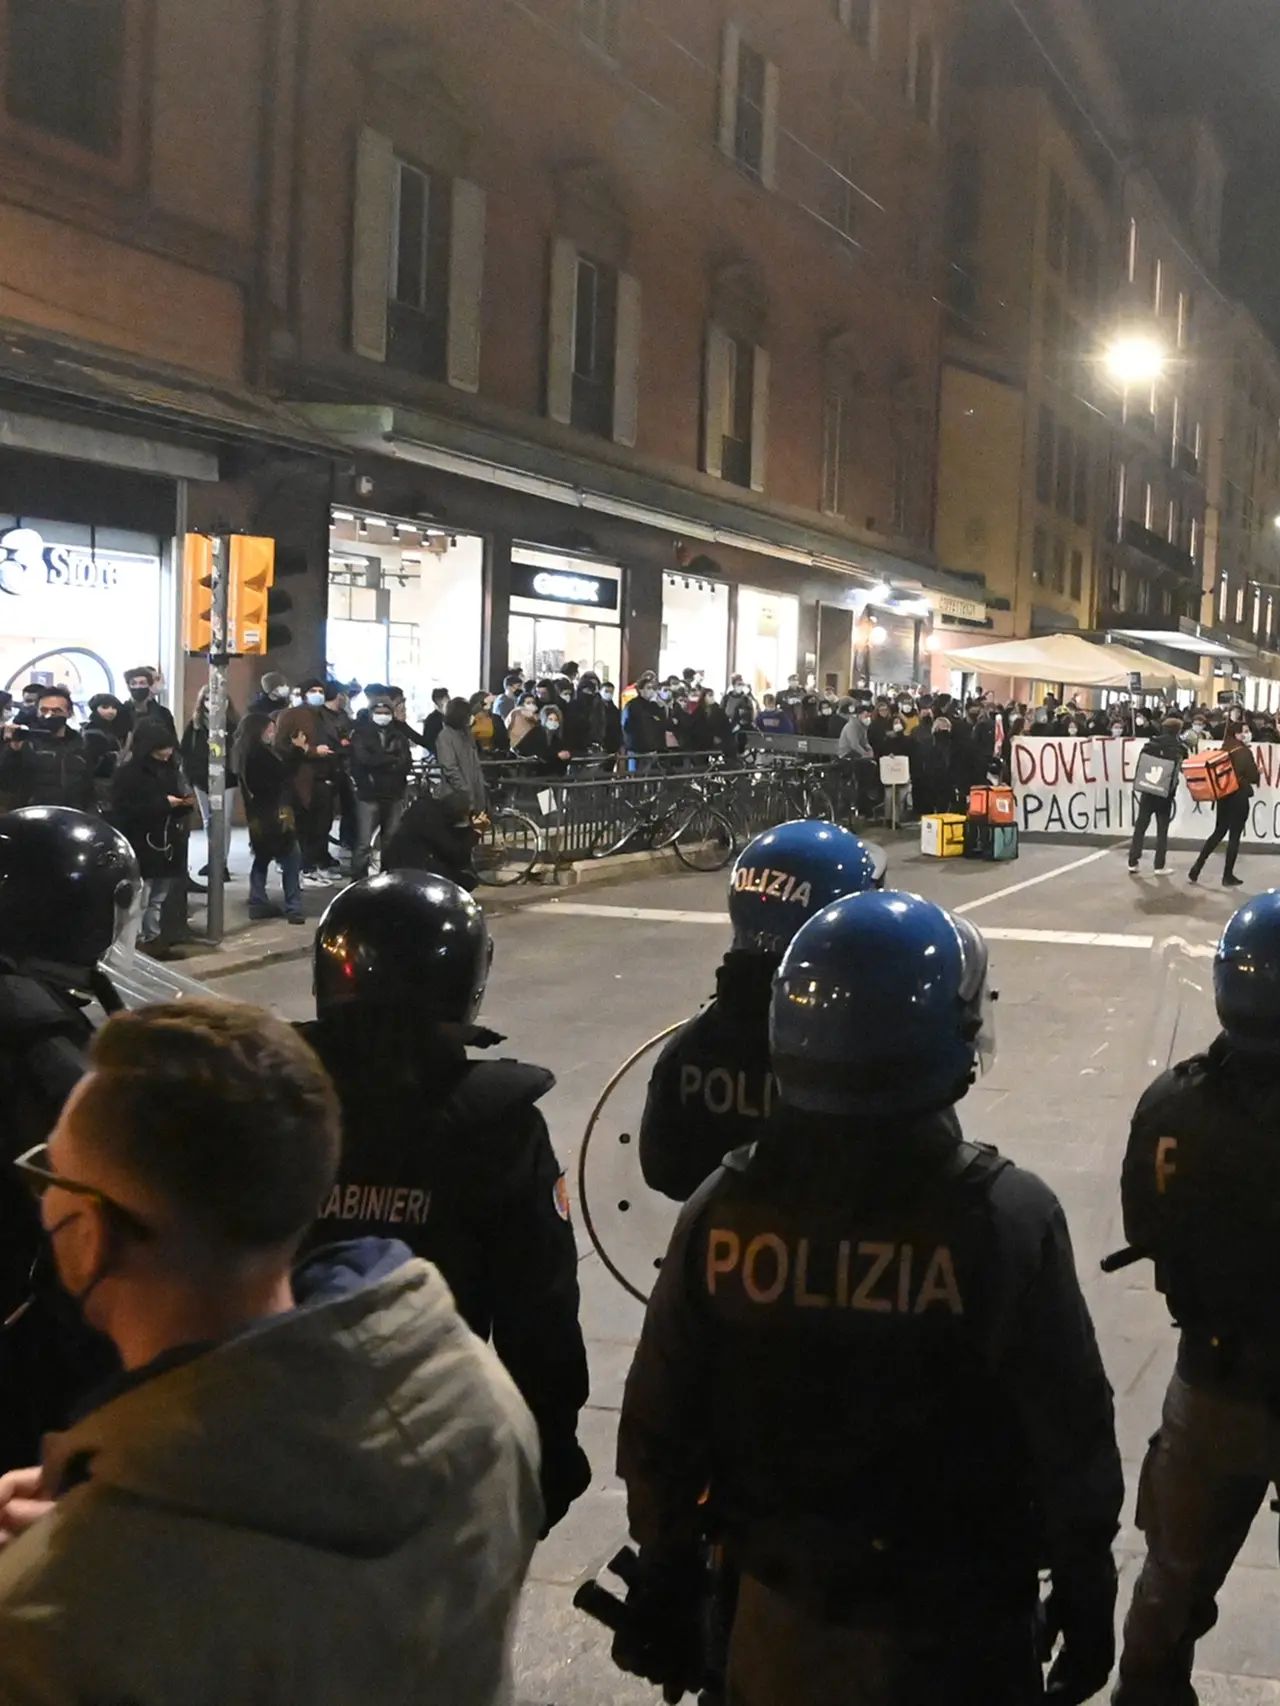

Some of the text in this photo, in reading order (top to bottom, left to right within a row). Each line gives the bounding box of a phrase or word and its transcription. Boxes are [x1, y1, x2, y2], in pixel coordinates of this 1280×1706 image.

[733, 866, 812, 908] OLIZIA
[681, 1064, 773, 1119] POLI
[317, 1184, 432, 1224] ABINIERI
[706, 1228, 964, 1315] POLIZIA
